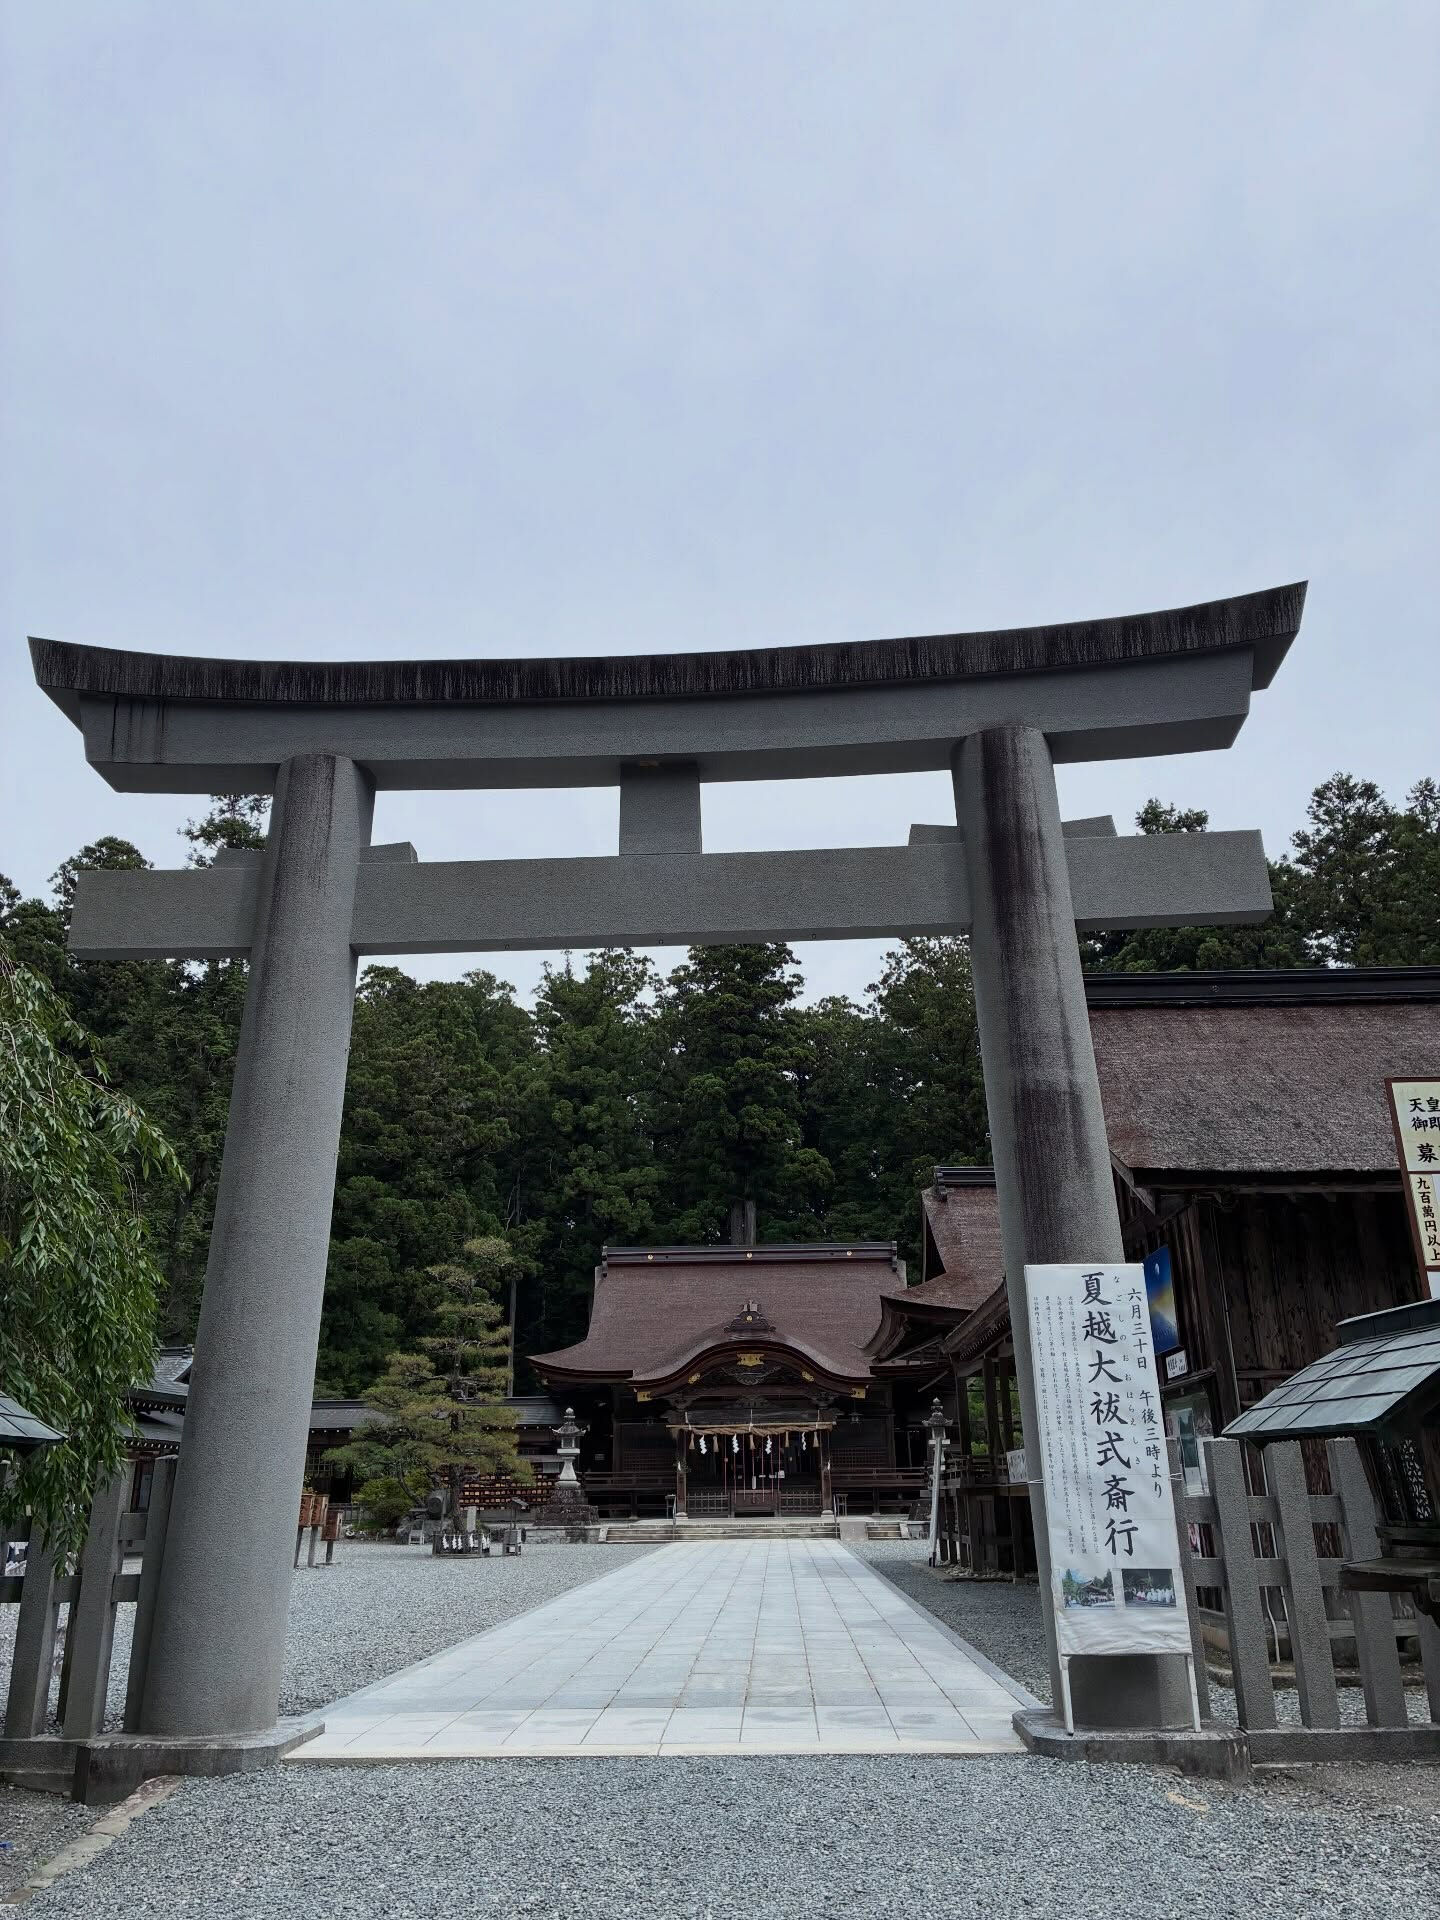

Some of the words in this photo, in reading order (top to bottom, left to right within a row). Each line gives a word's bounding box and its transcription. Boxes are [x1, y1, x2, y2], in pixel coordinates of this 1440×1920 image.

[1127, 1288, 1148, 1370] 六月三十日
[1139, 1390, 1162, 1499] 午後三時より
